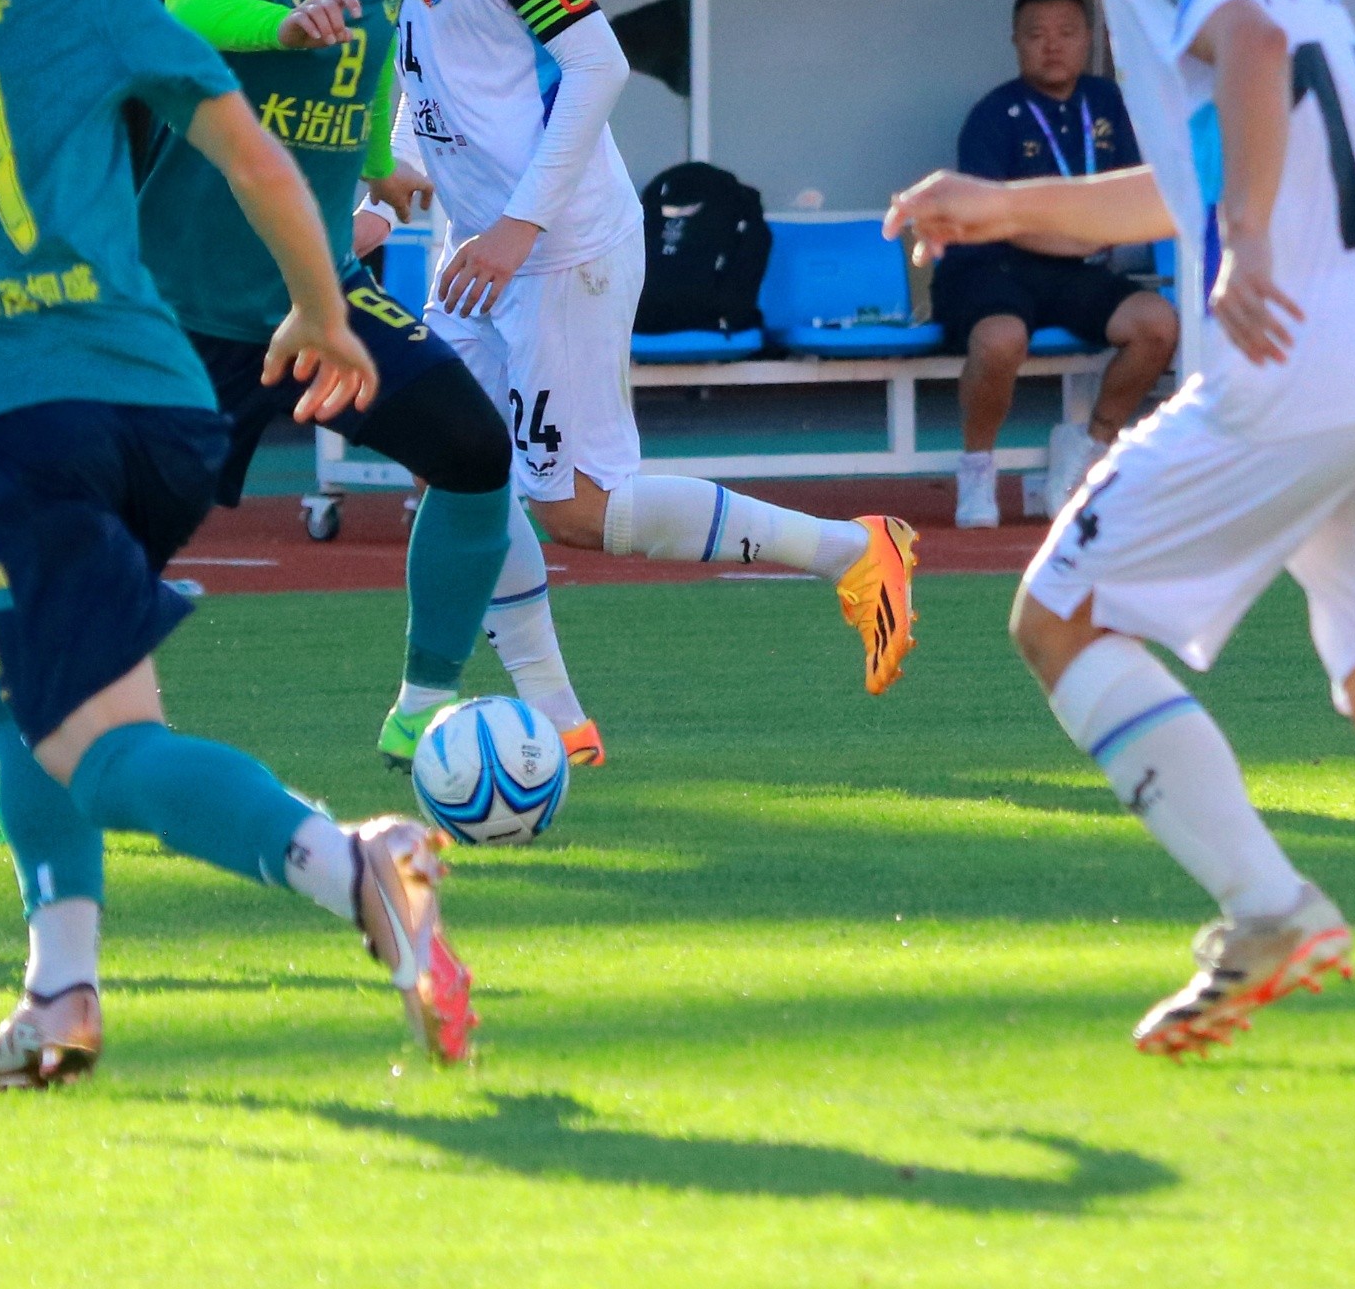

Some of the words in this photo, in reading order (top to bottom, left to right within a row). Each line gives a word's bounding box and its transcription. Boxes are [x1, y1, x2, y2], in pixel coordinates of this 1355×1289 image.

[330, 27, 367, 99] 8
[259, 93, 374, 146] 长治汇
[346, 287, 416, 329] 8
[509, 388, 562, 453] 24
